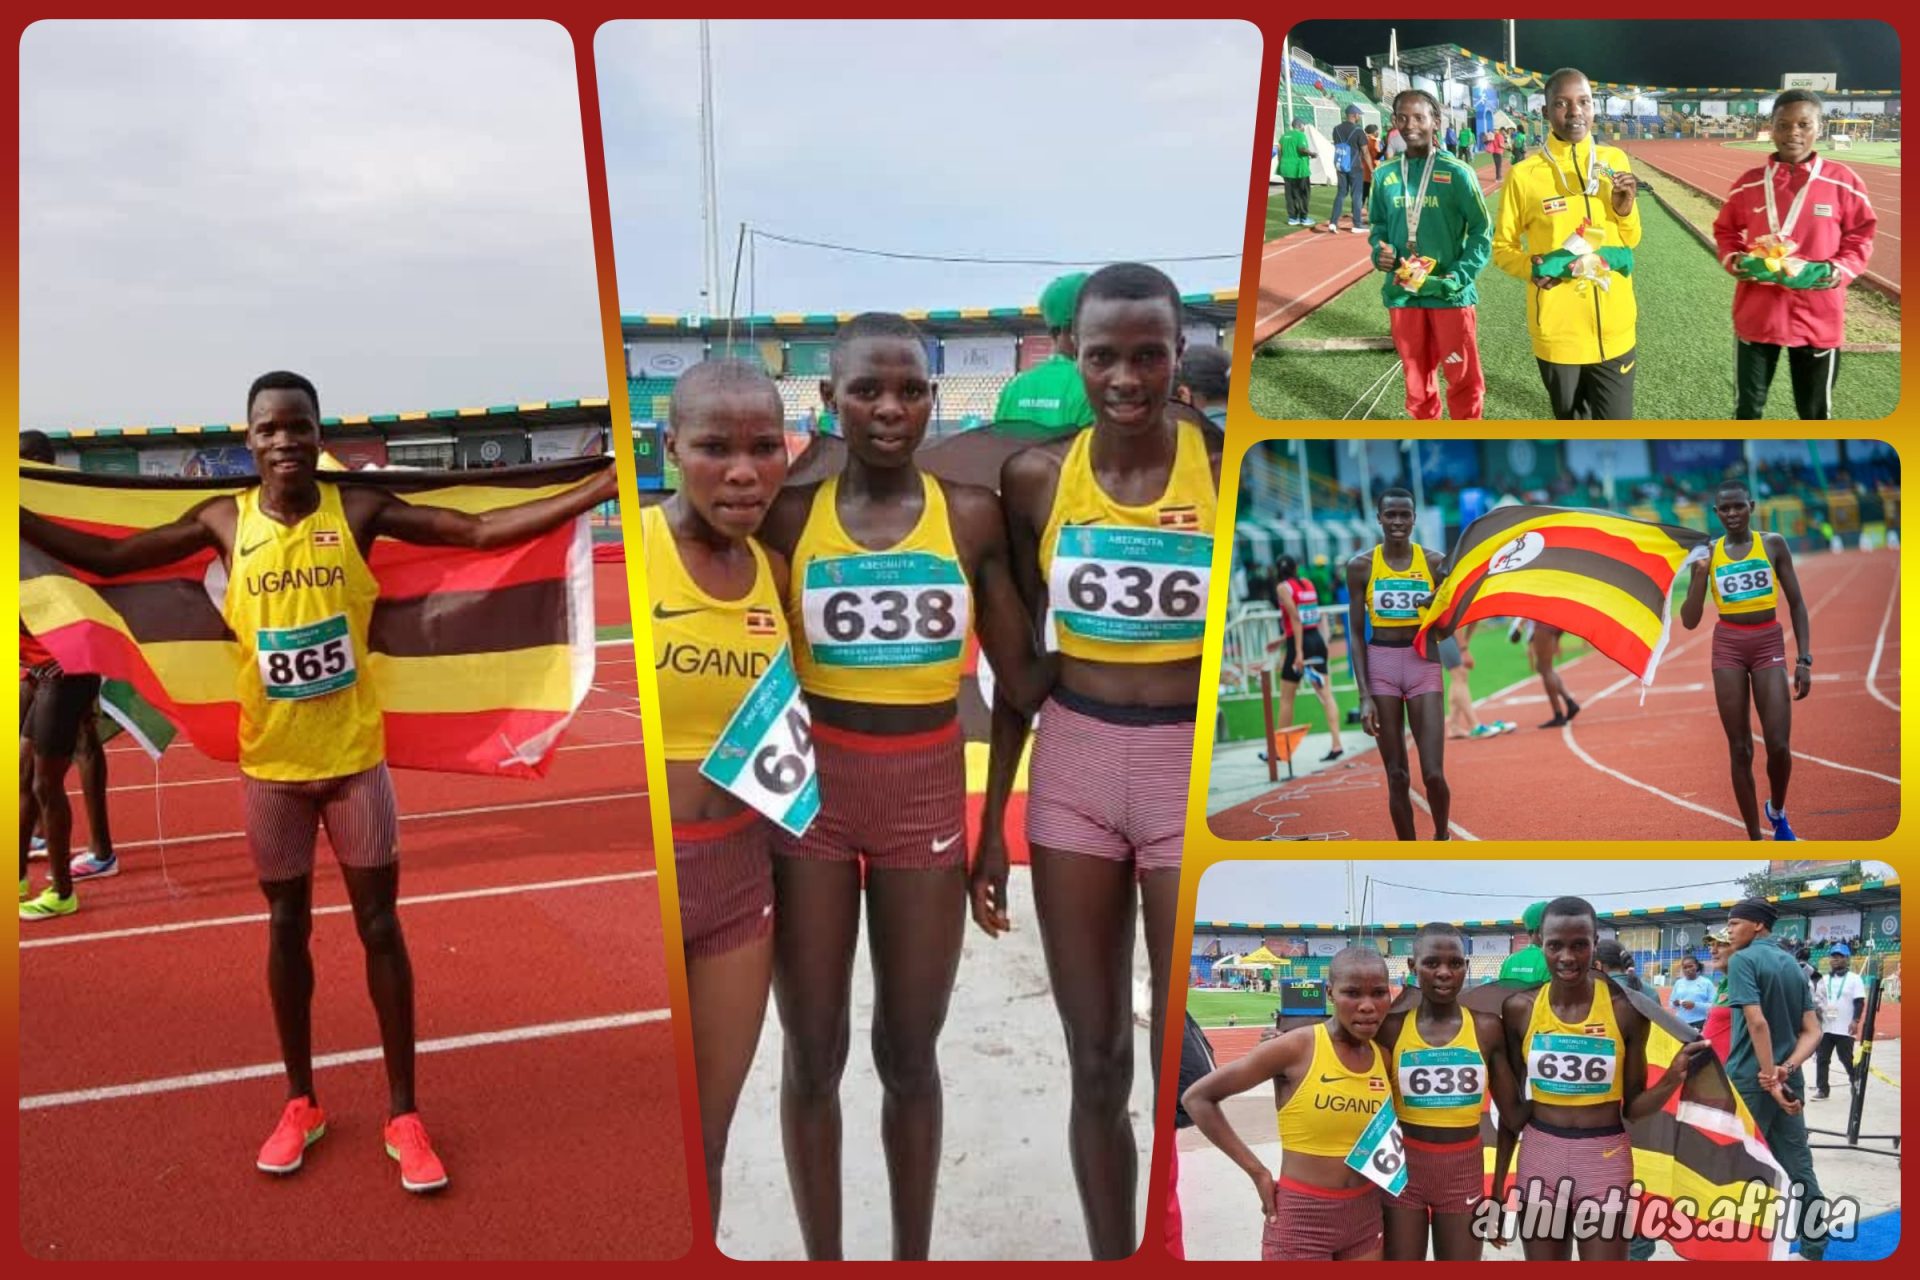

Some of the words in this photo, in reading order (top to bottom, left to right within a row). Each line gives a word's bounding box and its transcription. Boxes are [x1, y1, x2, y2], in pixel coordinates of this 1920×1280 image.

[1393, 195, 1439, 208] ETIPIA
[246, 566, 346, 596] UGANDA
[1068, 563, 1201, 618] 636
[1723, 570, 1769, 594] 638
[823, 588, 956, 642] 638
[1380, 591, 1426, 610] 636
[268, 639, 346, 684] 865
[656, 642, 771, 680] UGAND
[753, 706, 812, 795] 64
[1409, 1067, 1479, 1095] 638
[1537, 1053, 1607, 1082] 636
[1314, 1093, 1383, 1114] UGAND
[1372, 1128, 1404, 1175] 64
